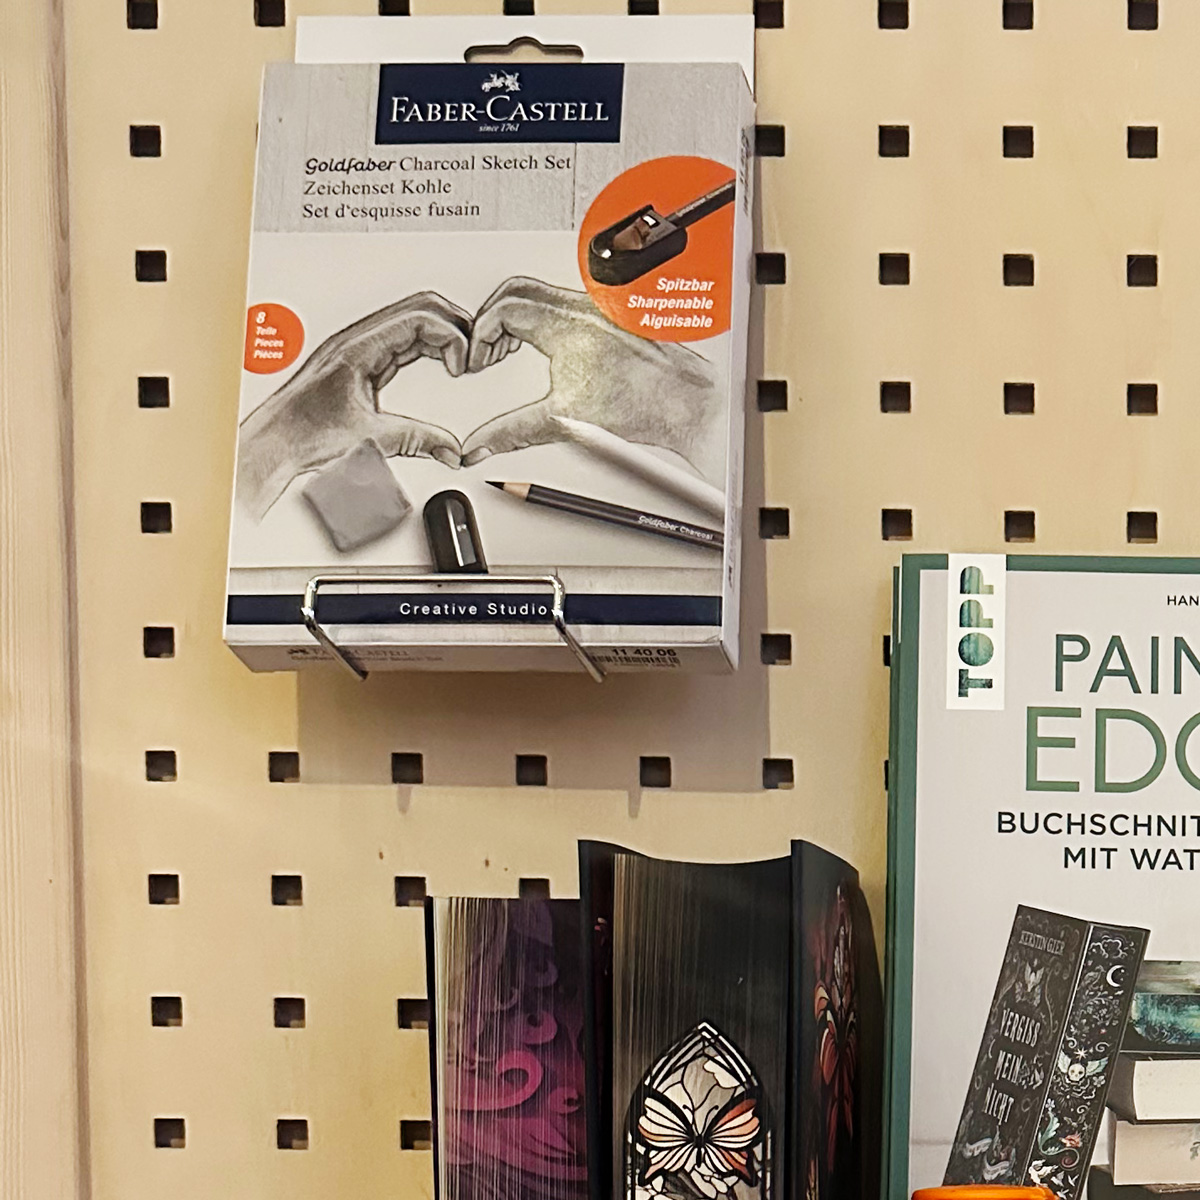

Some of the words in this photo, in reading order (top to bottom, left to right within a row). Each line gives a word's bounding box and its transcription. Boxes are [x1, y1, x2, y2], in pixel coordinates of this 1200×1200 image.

[389, 95, 610, 123] FABER-CASTELL
[479, 125, 500, 133] since
[500, 123, 520, 133] 1761
[305, 157, 397, 175] Goldfaber
[400, 155, 476, 171] Charcoal
[482, 155, 538, 170] Sketch
[544, 155, 572, 169] Set
[303, 180, 395, 196] Zeichenset
[401, 179, 452, 194] Kohle
[302, 203, 329, 219] Set
[428, 202, 480, 217] fusain
[657, 278, 715, 293] Spitzbar
[627, 295, 714, 311] Sharpenable
[256, 311, 266, 324] 8
[639, 314, 713, 329] Aiguisable
[399, 602, 478, 616] Creative
[487, 603, 548, 615] Studio
[957, 565, 995, 698] TOPP
[612, 648, 627, 656] 11
[634, 648, 653, 656] 40
[656, 649, 677, 657] 06
[1063, 847, 1118, 870] MIT
[1000, 1008, 1041, 1048] VERGISS
[993, 1049, 1023, 1084] MEIN
[983, 1082, 1015, 1126] NICHT
